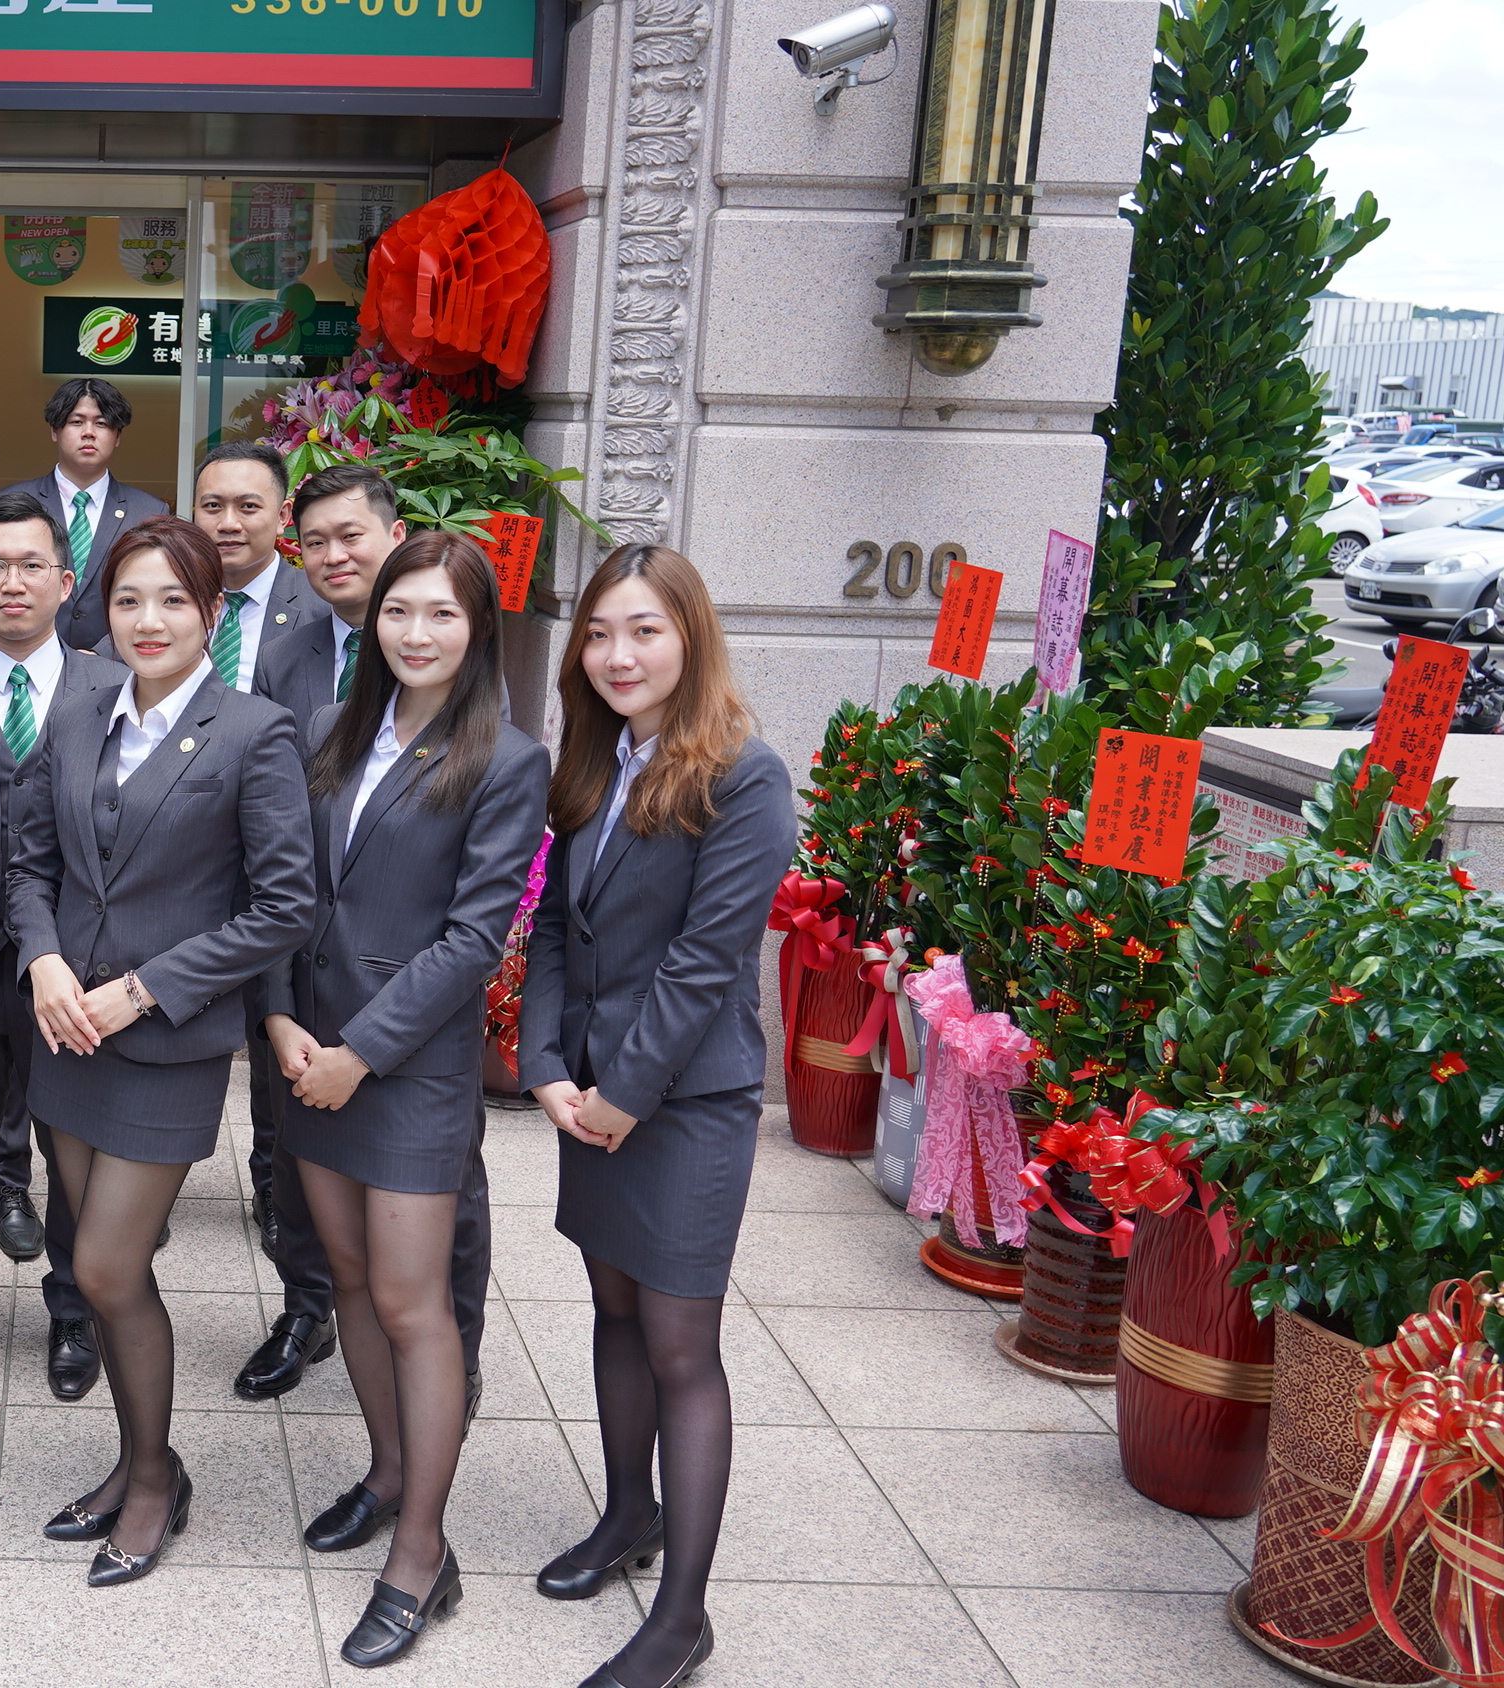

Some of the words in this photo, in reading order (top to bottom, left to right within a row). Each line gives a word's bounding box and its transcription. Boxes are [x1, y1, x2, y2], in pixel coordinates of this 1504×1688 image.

[20, 228, 43, 238] NEW
[44, 227, 70, 236] OPEN
[143, 220, 177, 237] 服務
[271, 232, 295, 241] OPEN
[843, 540, 967, 599] 200
[1045, 546, 1077, 671] 開幕誌慶
[1393, 661, 1440, 788] 開幕誌慶
[1121, 743, 1161, 865] 開業誌慶
